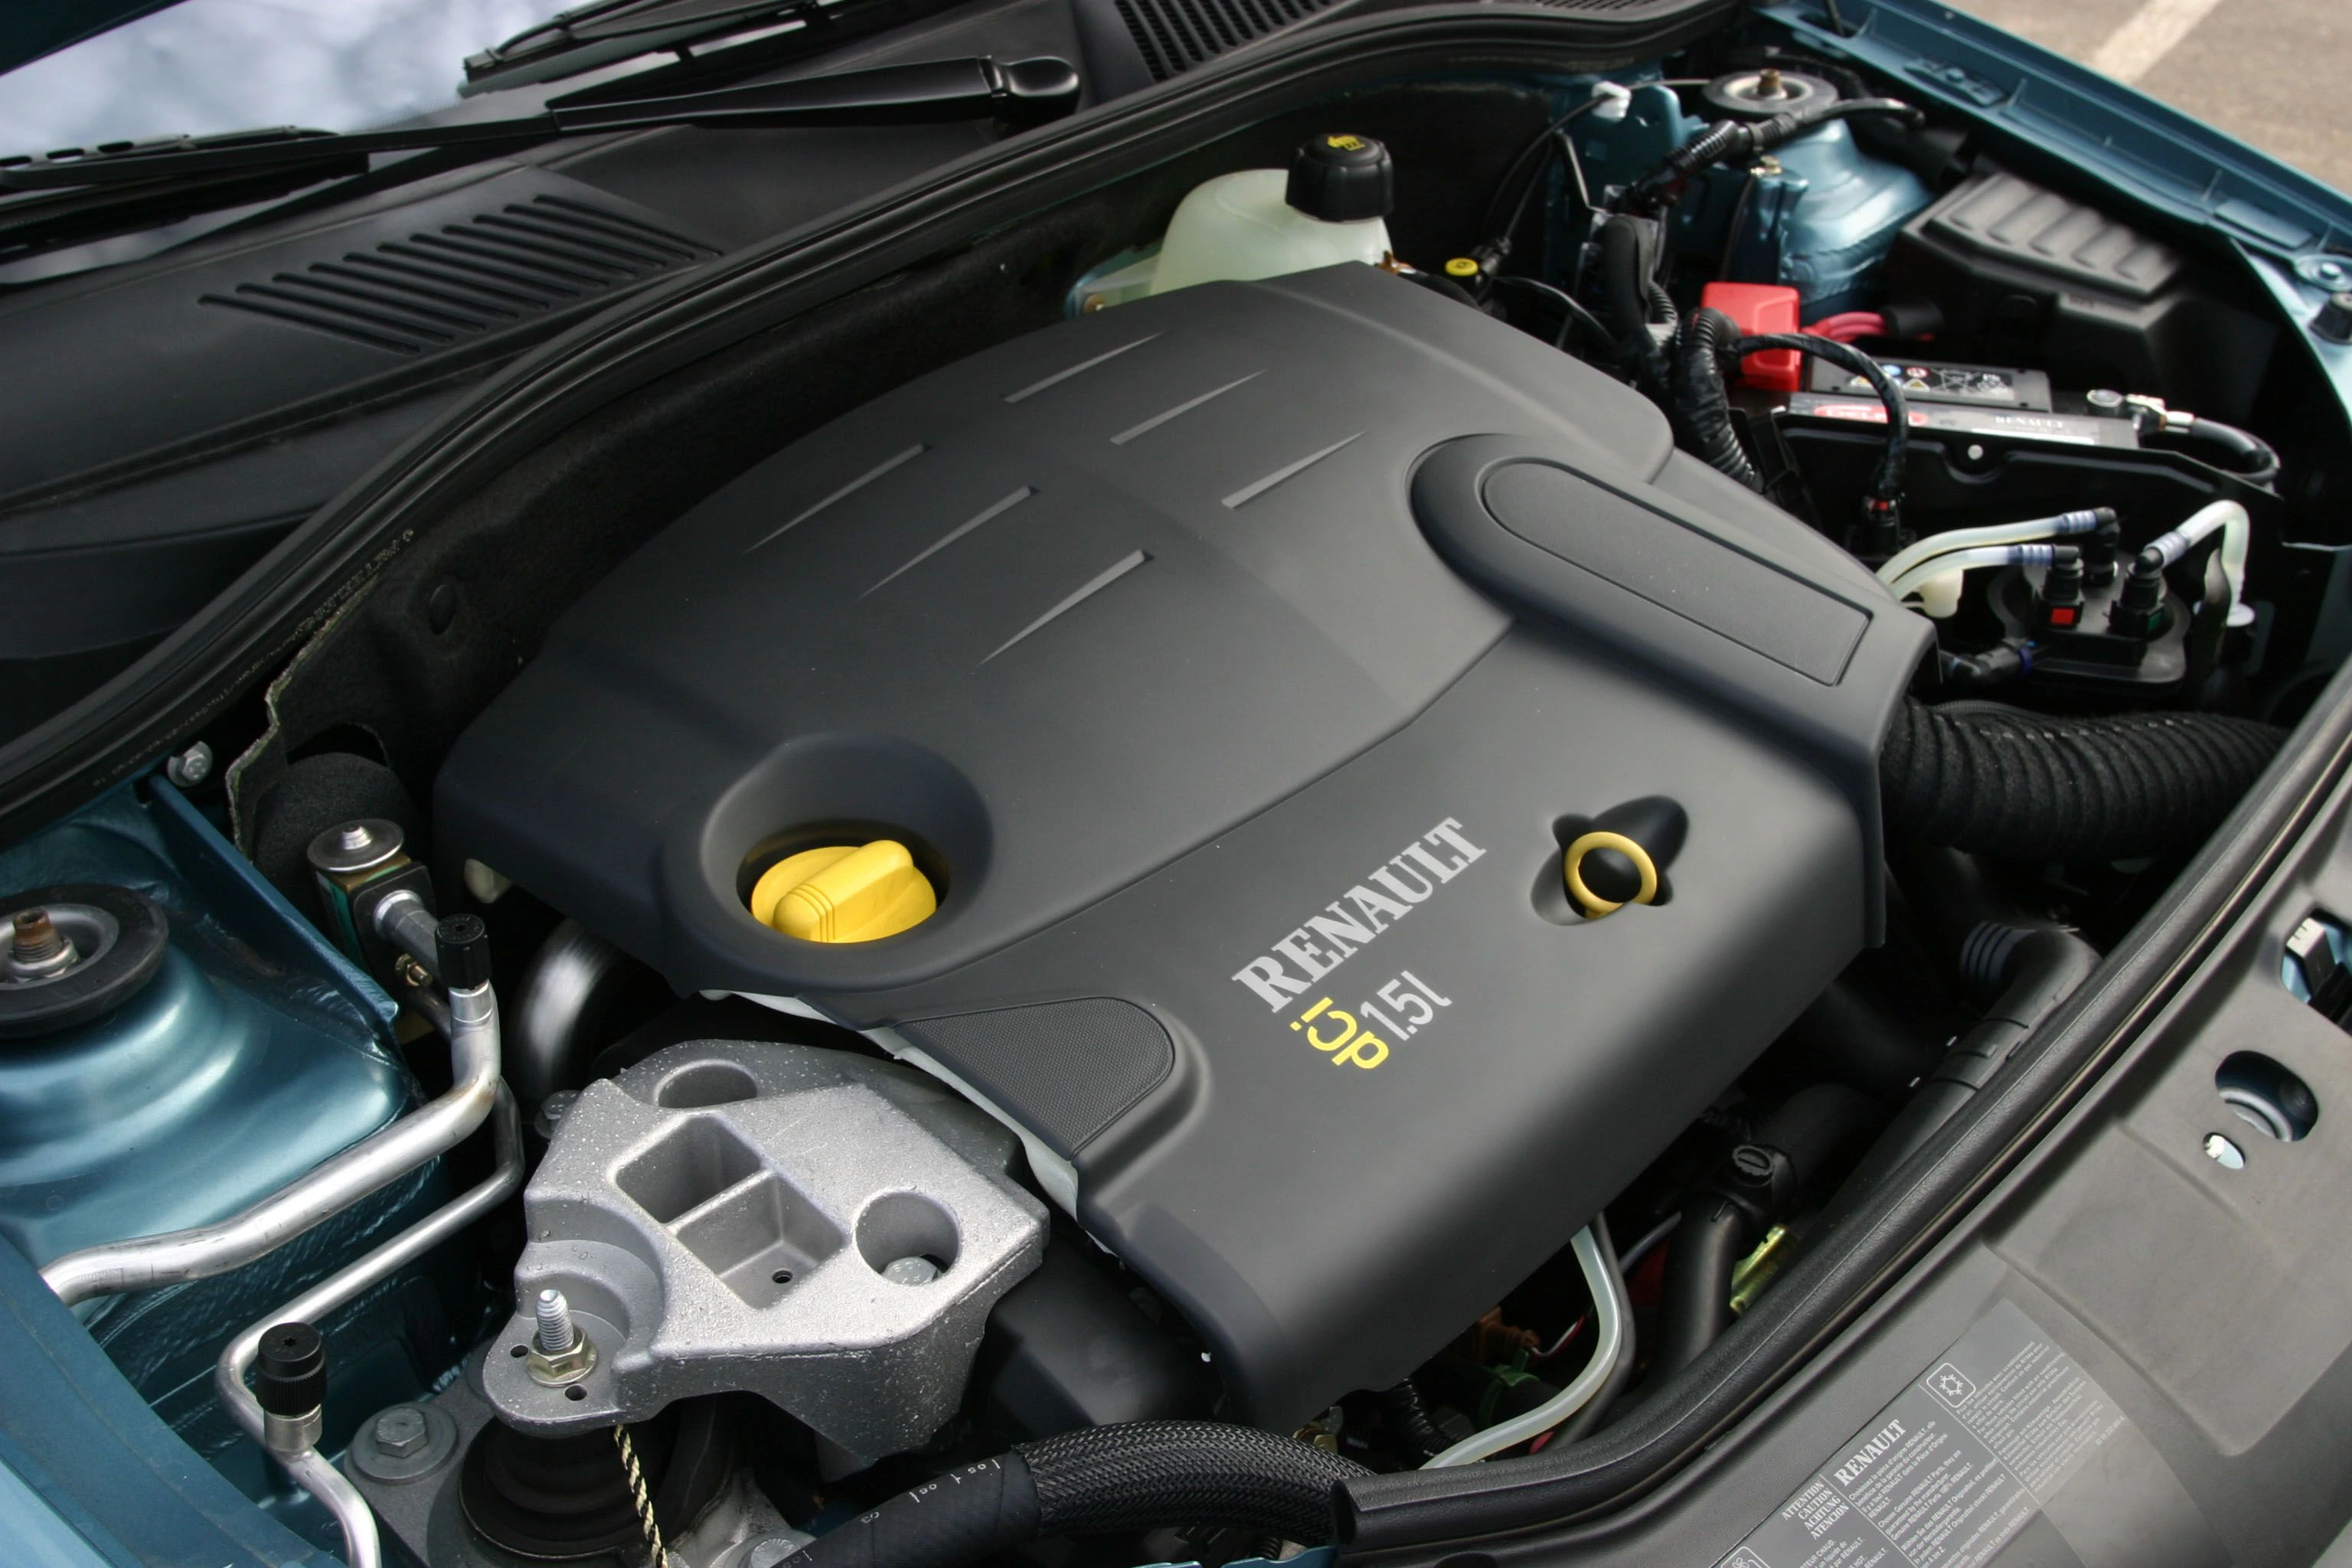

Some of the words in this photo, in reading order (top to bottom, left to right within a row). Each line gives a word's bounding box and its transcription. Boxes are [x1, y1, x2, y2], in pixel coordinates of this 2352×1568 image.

[1231, 816, 1487, 1014] RENAULT
[1833, 1418, 1907, 1485] RENAULT
[1781, 1481, 1825, 1521] ATTENTION
[1798, 1488, 1834, 1521] CAUTION
[1803, 1494, 1841, 1530] ACHTUNG
[1808, 1502, 1850, 1540] ATENCION
